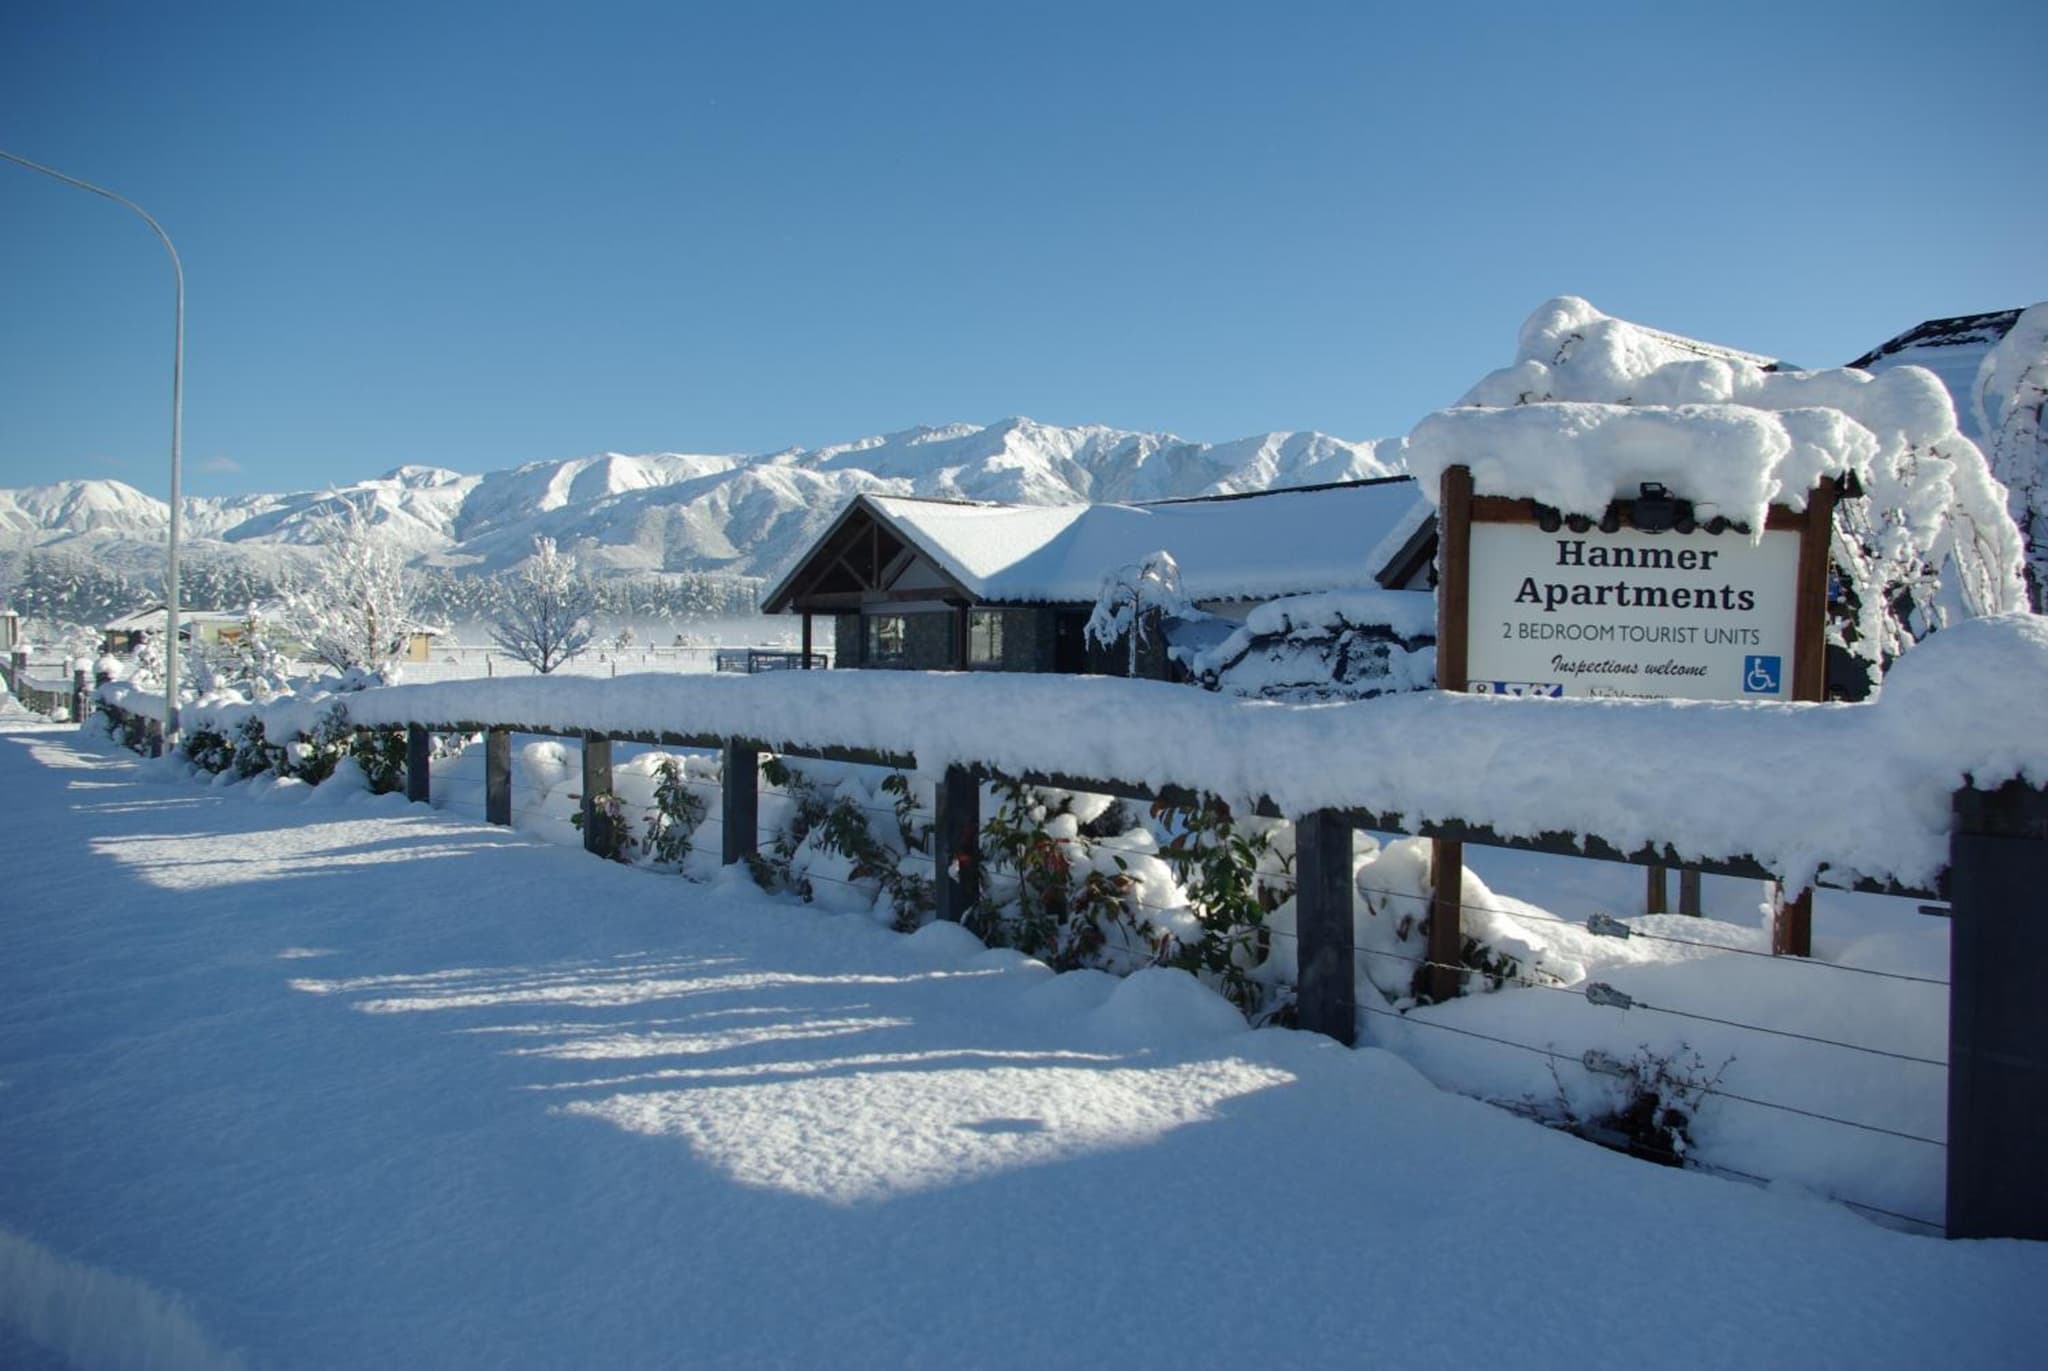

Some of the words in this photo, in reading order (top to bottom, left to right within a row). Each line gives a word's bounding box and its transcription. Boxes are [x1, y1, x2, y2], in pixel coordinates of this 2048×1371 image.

[1555, 540, 1719, 571] Hanmer
[1514, 577, 1755, 612] Apartments
[1502, 622, 1513, 639] 2
[1518, 623, 1615, 642] BEDROOM
[1619, 625, 1699, 644] TOURIST
[1704, 628, 1760, 645] UNITS
[1551, 654, 1639, 676] Inspections
[1644, 660, 1709, 677] welcome
